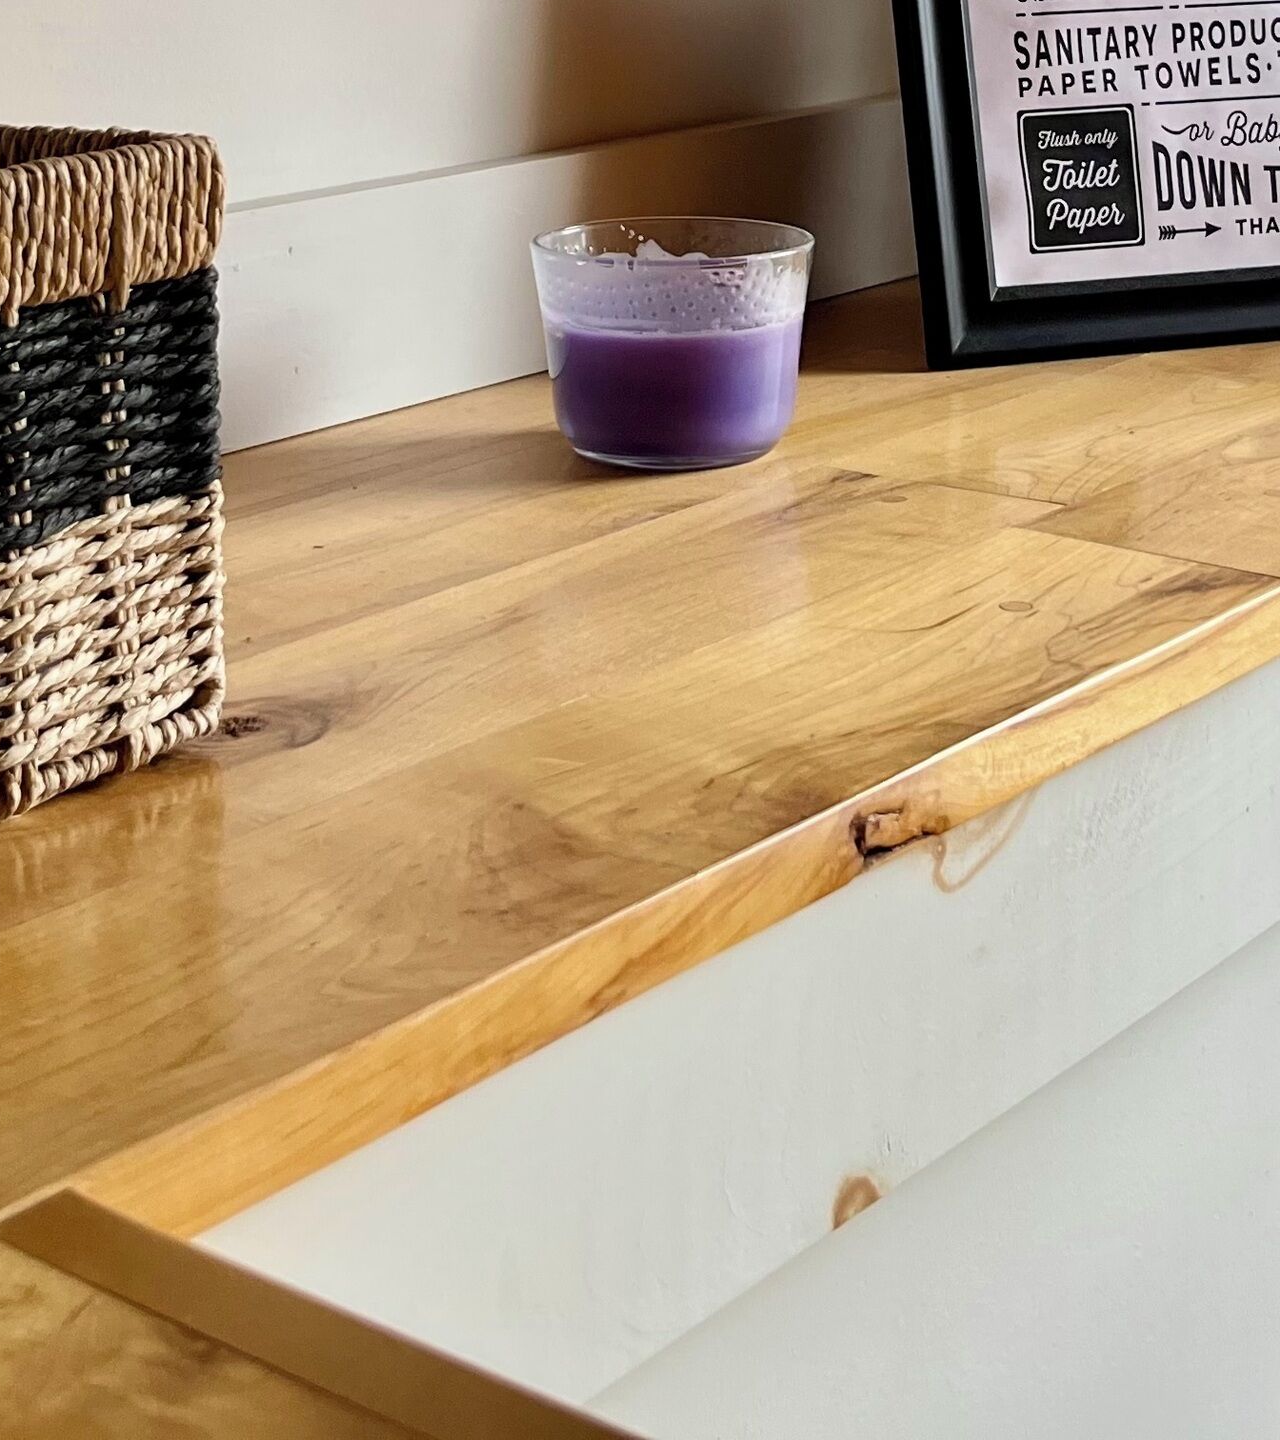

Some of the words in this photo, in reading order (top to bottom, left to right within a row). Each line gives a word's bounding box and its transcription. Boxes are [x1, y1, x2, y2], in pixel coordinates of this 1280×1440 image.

[1014, 23, 1158, 71] SANITARY
[1018, 72, 1119, 98] PAPER
[1037, 129, 1082, 150] Flush
[1084, 127, 1118, 150] only
[1189, 121, 1214, 141] or
[1042, 158, 1120, 193] Toilet
[1152, 140, 1252, 211] DOWN
[1045, 197, 1125, 236] Paper
